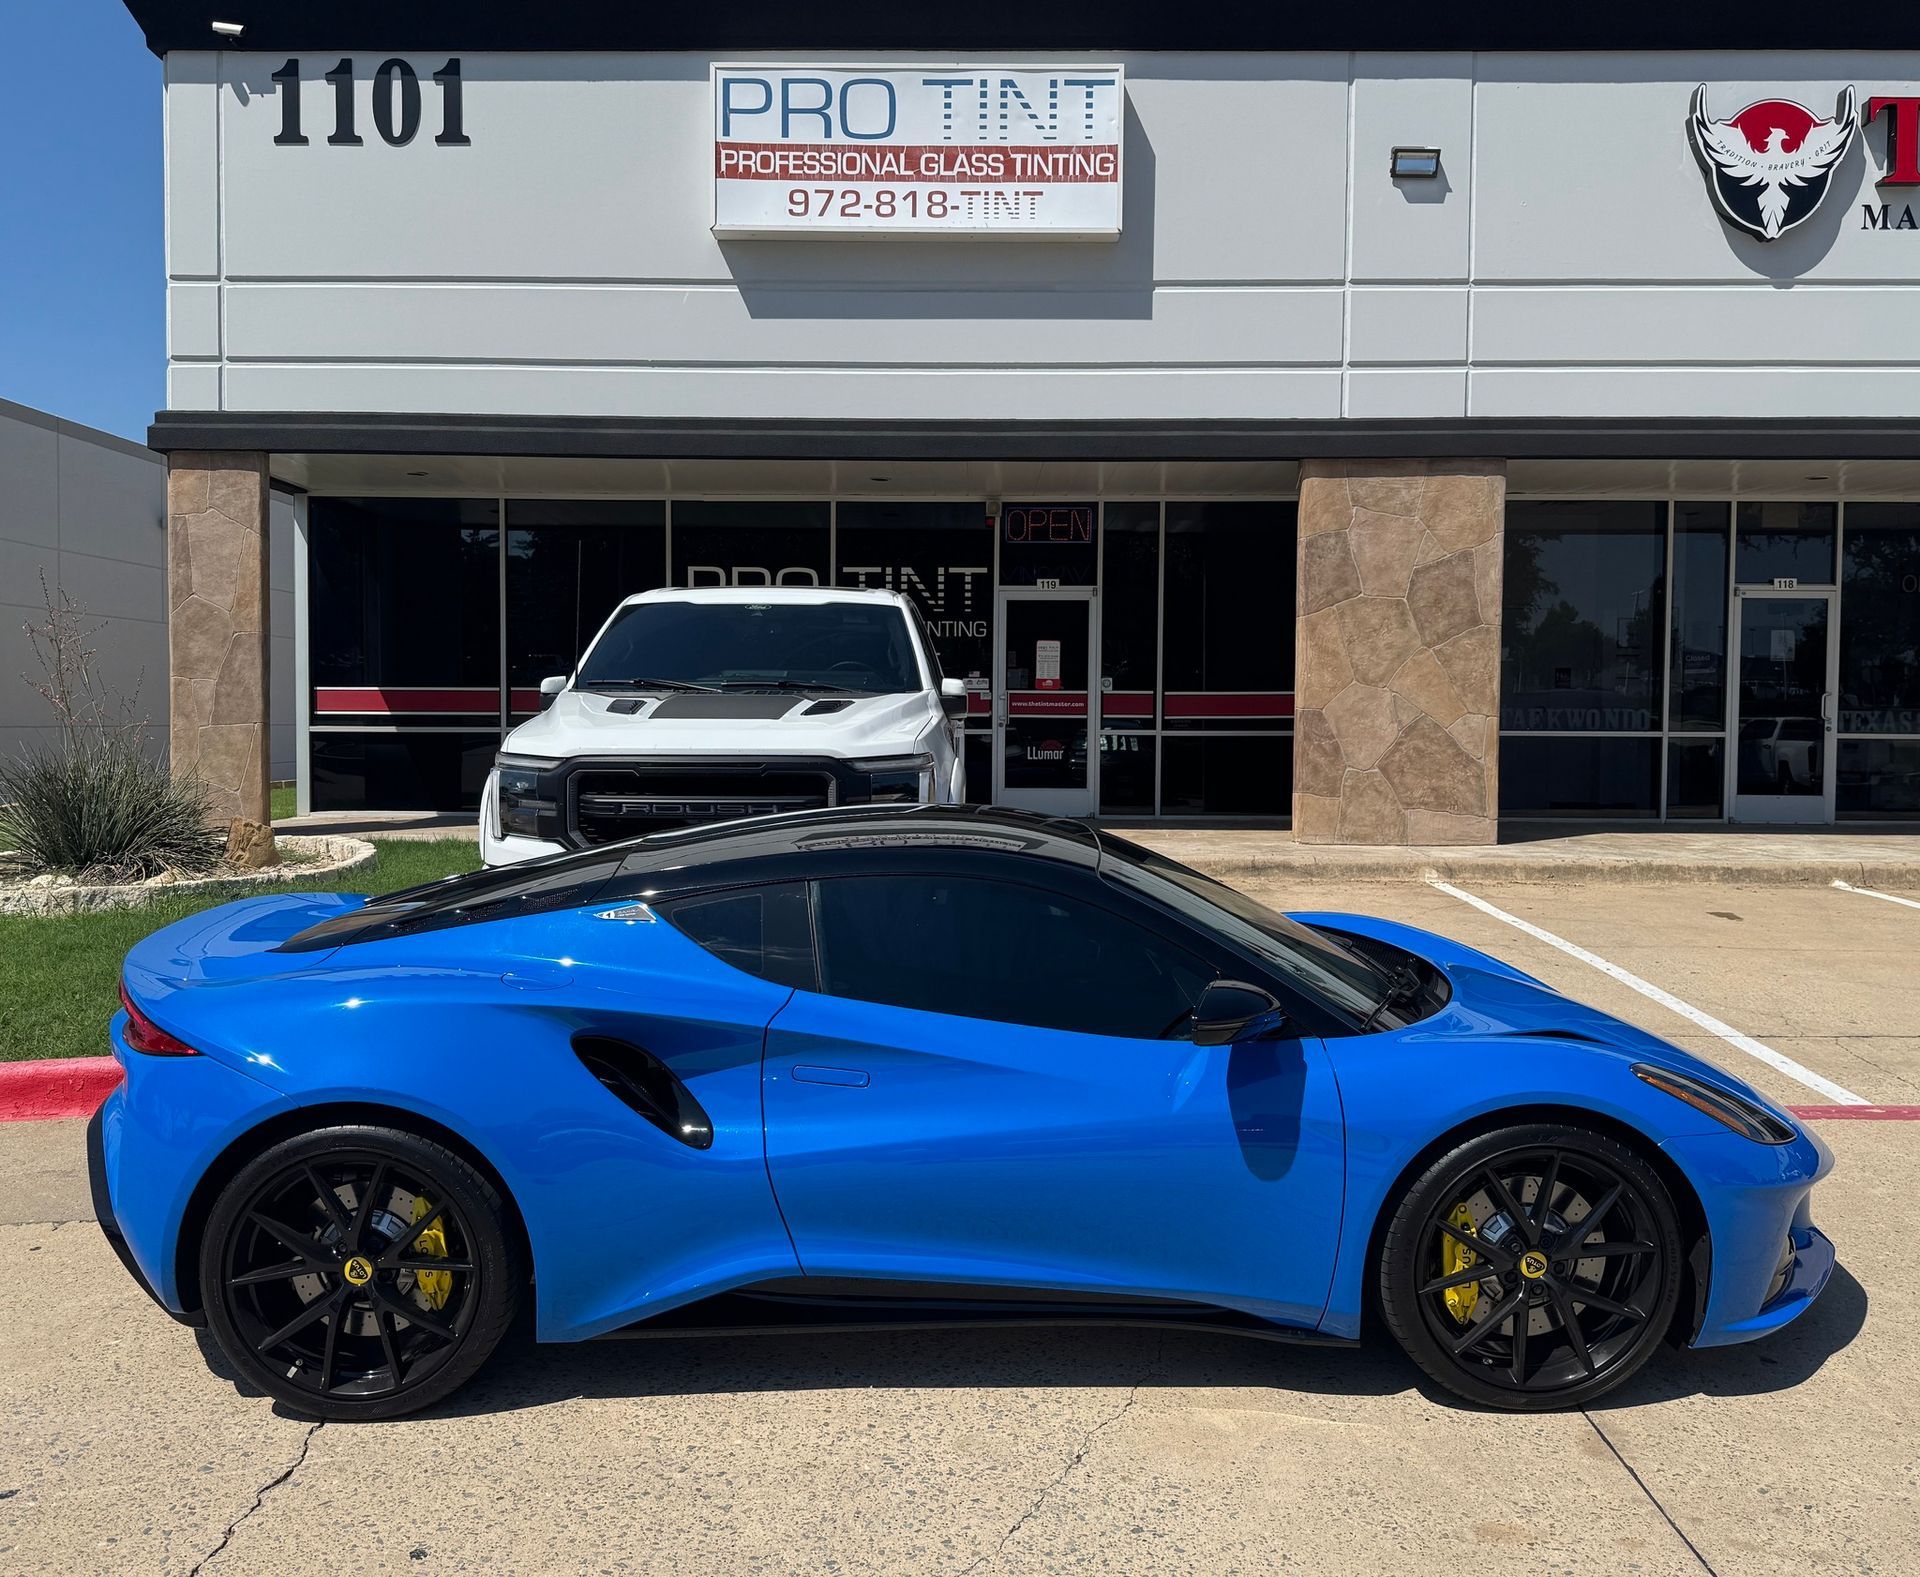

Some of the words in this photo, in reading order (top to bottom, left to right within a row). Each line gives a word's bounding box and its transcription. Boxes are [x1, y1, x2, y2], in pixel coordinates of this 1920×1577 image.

[271, 58, 471, 147] 1101
[721, 77, 897, 140] PRO
[922, 79, 1116, 141] TINT
[719, 149, 914, 177] PROFESSIONAL
[919, 153, 1005, 177] GLASS
[1010, 153, 1117, 178] TINTING
[1716, 140, 1758, 168] TRADITION
[1767, 158, 1805, 171] BRAVERY
[1814, 140, 1832, 157] GRIT
[787, 188, 1044, 221] 972-818-TINT
[1007, 509, 1091, 541] OPEN
[1040, 580, 1057, 589] 119
[1778, 579, 1794, 589] 118
[923, 620, 987, 638] NTING
[1011, 700, 1085, 708] www.thetintmaster.com
[1027, 745, 1064, 760] LLumar
[621, 803, 778, 815] ROUSH
